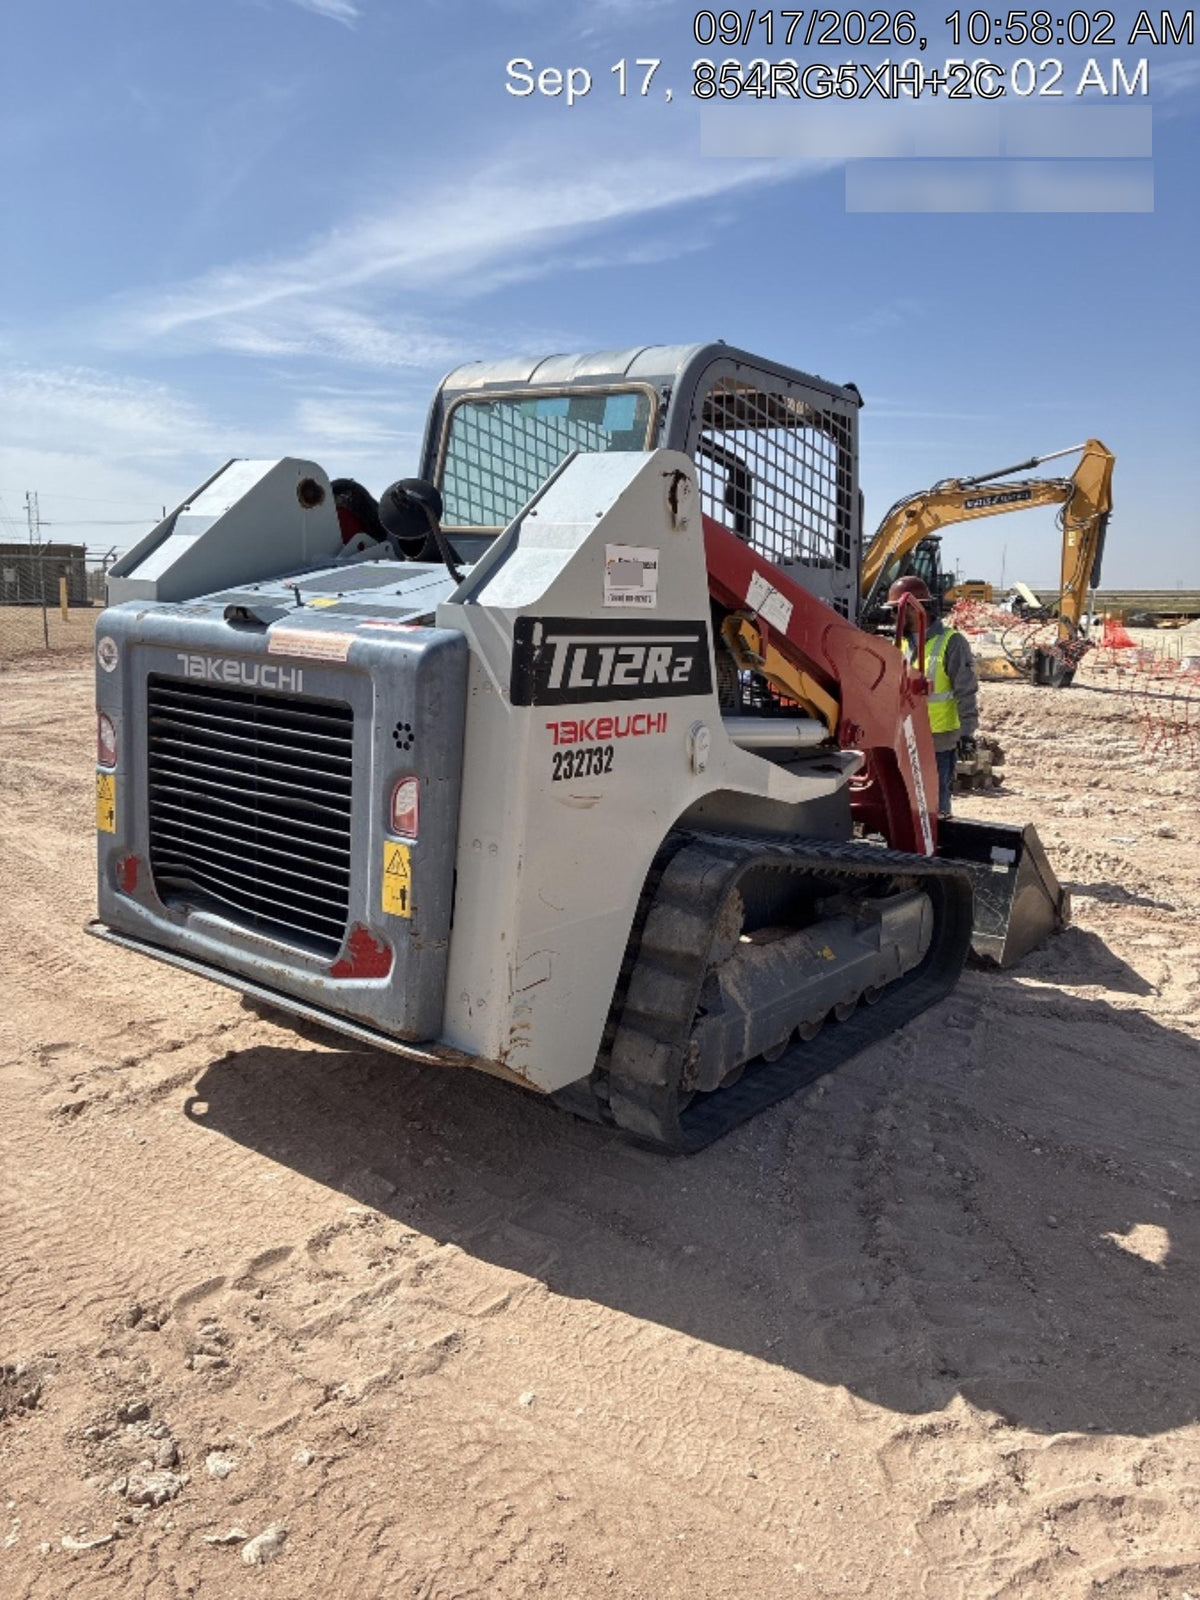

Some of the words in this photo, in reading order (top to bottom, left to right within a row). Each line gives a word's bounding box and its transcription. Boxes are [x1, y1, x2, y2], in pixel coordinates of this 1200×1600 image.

[177, 653, 303, 692] TAKEUCHI
[545, 634, 700, 689] TL12R2
[545, 712, 667, 745] TAKEUCHI
[552, 745, 614, 781] 232732
